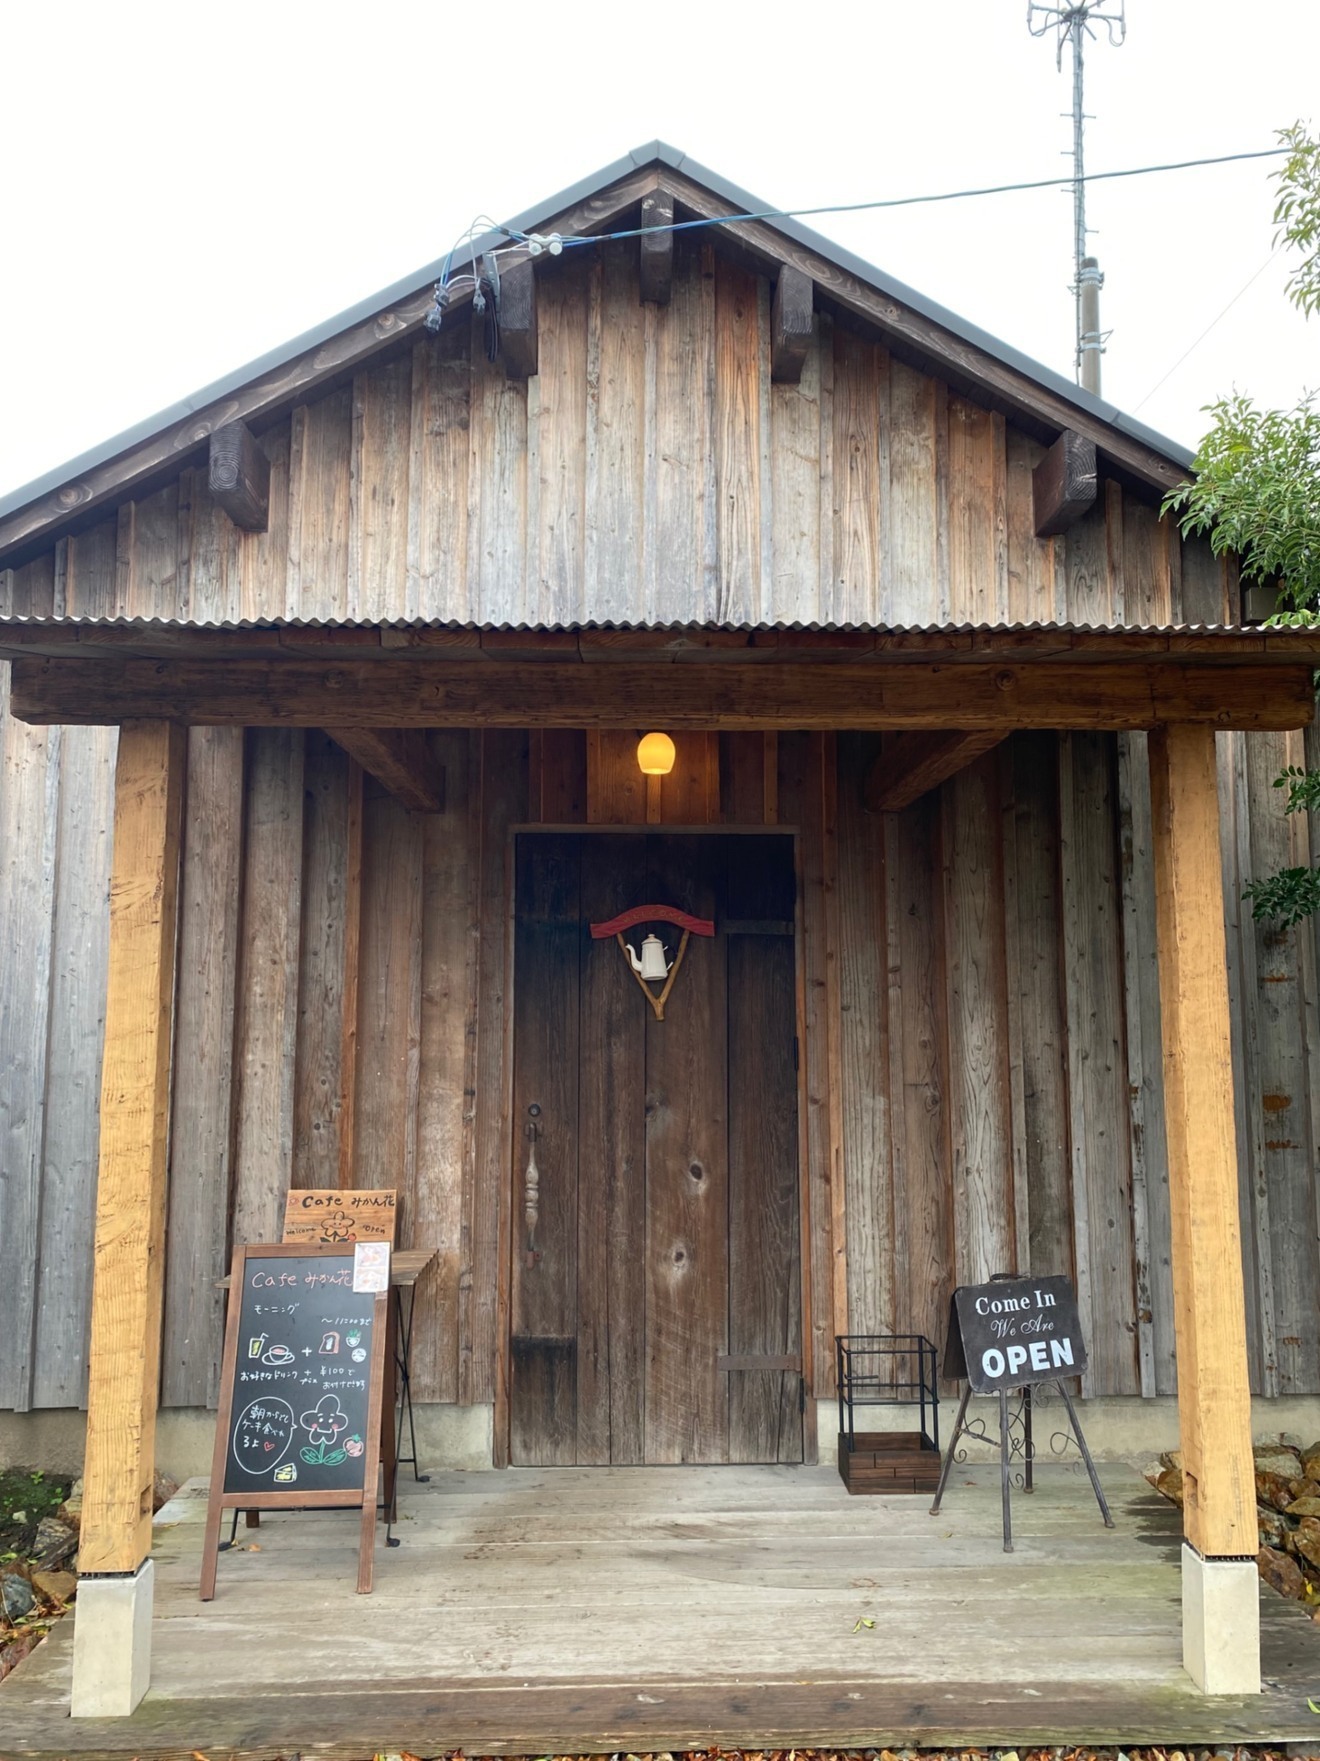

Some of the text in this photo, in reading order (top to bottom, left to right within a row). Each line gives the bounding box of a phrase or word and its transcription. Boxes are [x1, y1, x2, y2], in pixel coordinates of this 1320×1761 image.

[302, 1194, 395, 1208] Cafe みかん花
[251, 1268, 353, 1288] Cafe みかん花
[254, 1302, 300, 1315] モーニング
[975, 1290, 1057, 1316] Come In
[990, 1314, 1055, 1339] We Are
[981, 1337, 1075, 1378] OPEN
